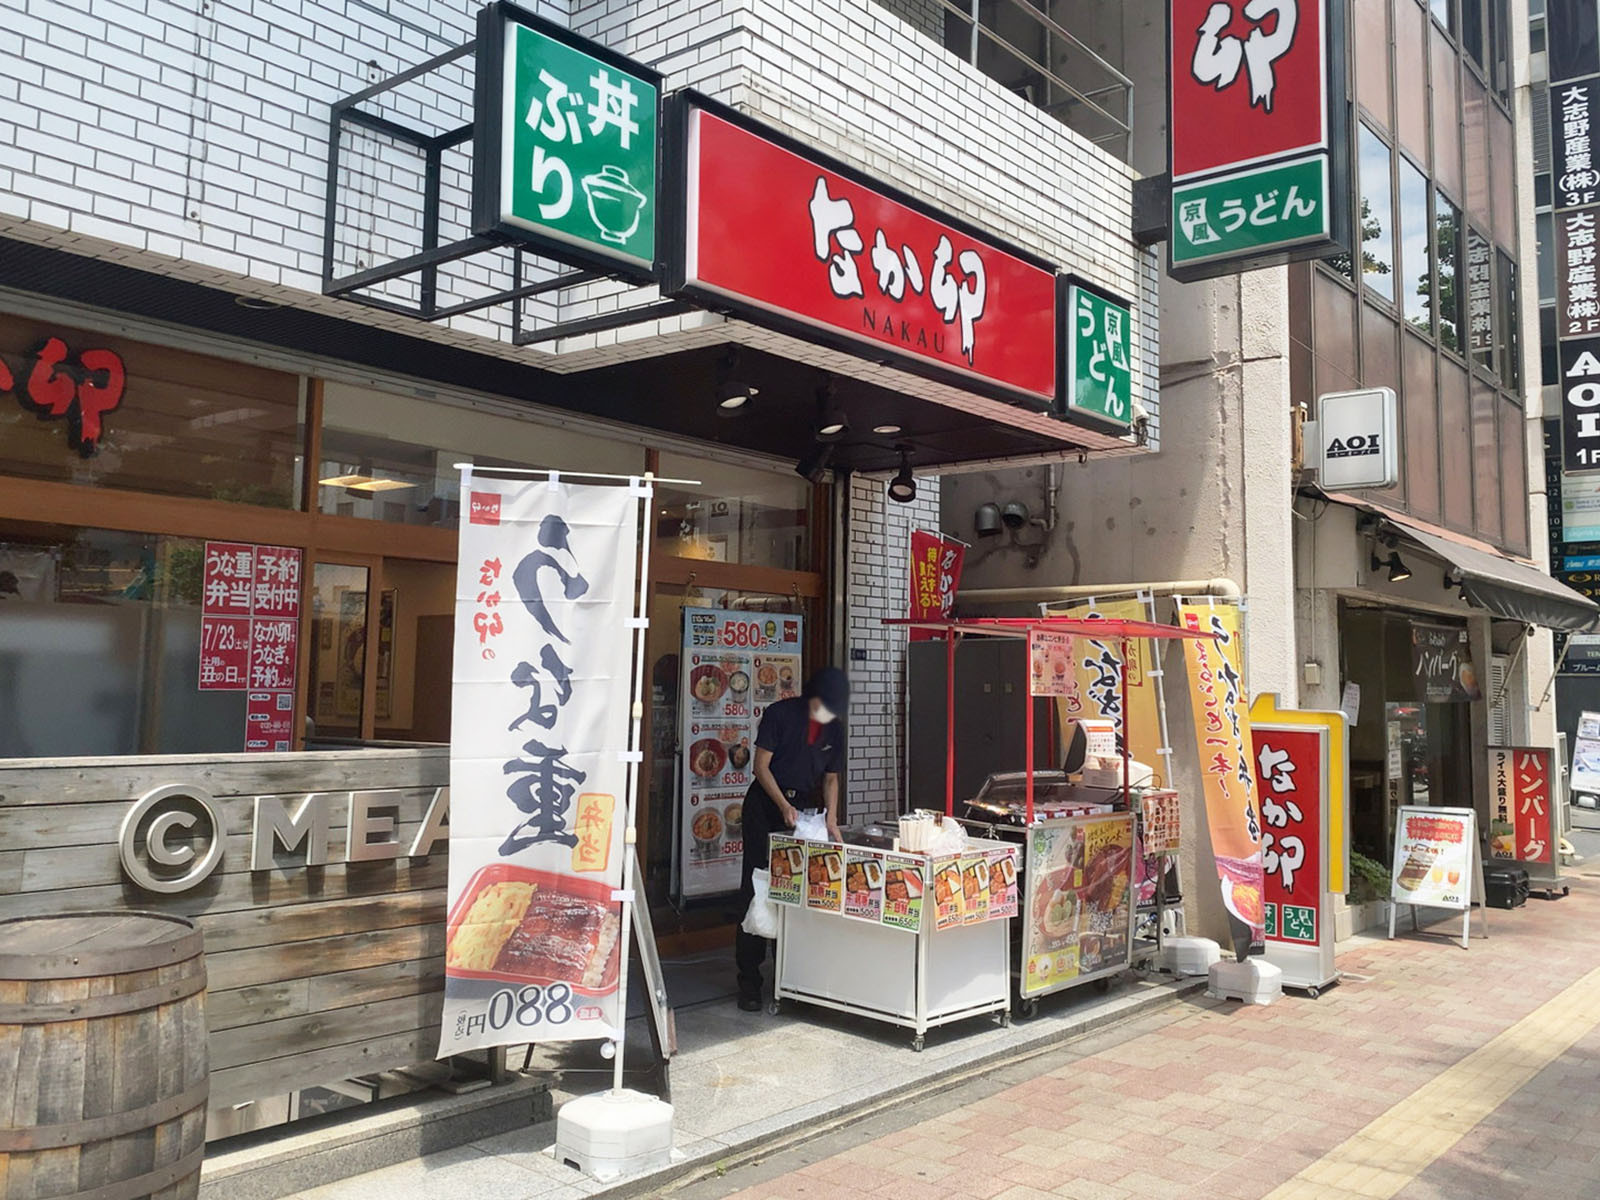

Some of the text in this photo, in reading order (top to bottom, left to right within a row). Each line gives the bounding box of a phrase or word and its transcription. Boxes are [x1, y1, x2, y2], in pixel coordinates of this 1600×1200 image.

[1192, 0, 1298, 113] 卯
[1559, 86, 1599, 191] 大志野産業(株)
[1219, 186, 1316, 233] うどん
[1566, 191, 1595, 206] 3F
[1184, 203, 1210, 242] 京風
[809, 176, 986, 365] なか卯
[1566, 212, 1600, 319] 大志野産業(株)
[863, 307, 945, 353] NAKAU
[1107, 312, 1124, 365] 京風
[1569, 320, 1600, 334] 2F
[1078, 296, 1124, 417] うどん
[0, 336, 126, 453] 卯
[1566, 351, 1600, 438] AOI
[1326, 434, 1380, 452] AOI
[1576, 449, 1600, 465] 1F
[207, 551, 252, 578] うな重
[258, 555, 299, 582] 予約
[206, 579, 250, 607] 弁当
[255, 584, 298, 611] 受付中
[1258, 743, 1305, 894] なか卯
[1519, 752, 1546, 861] ハンバーグ
[1285, 907, 1310, 938] うどん
